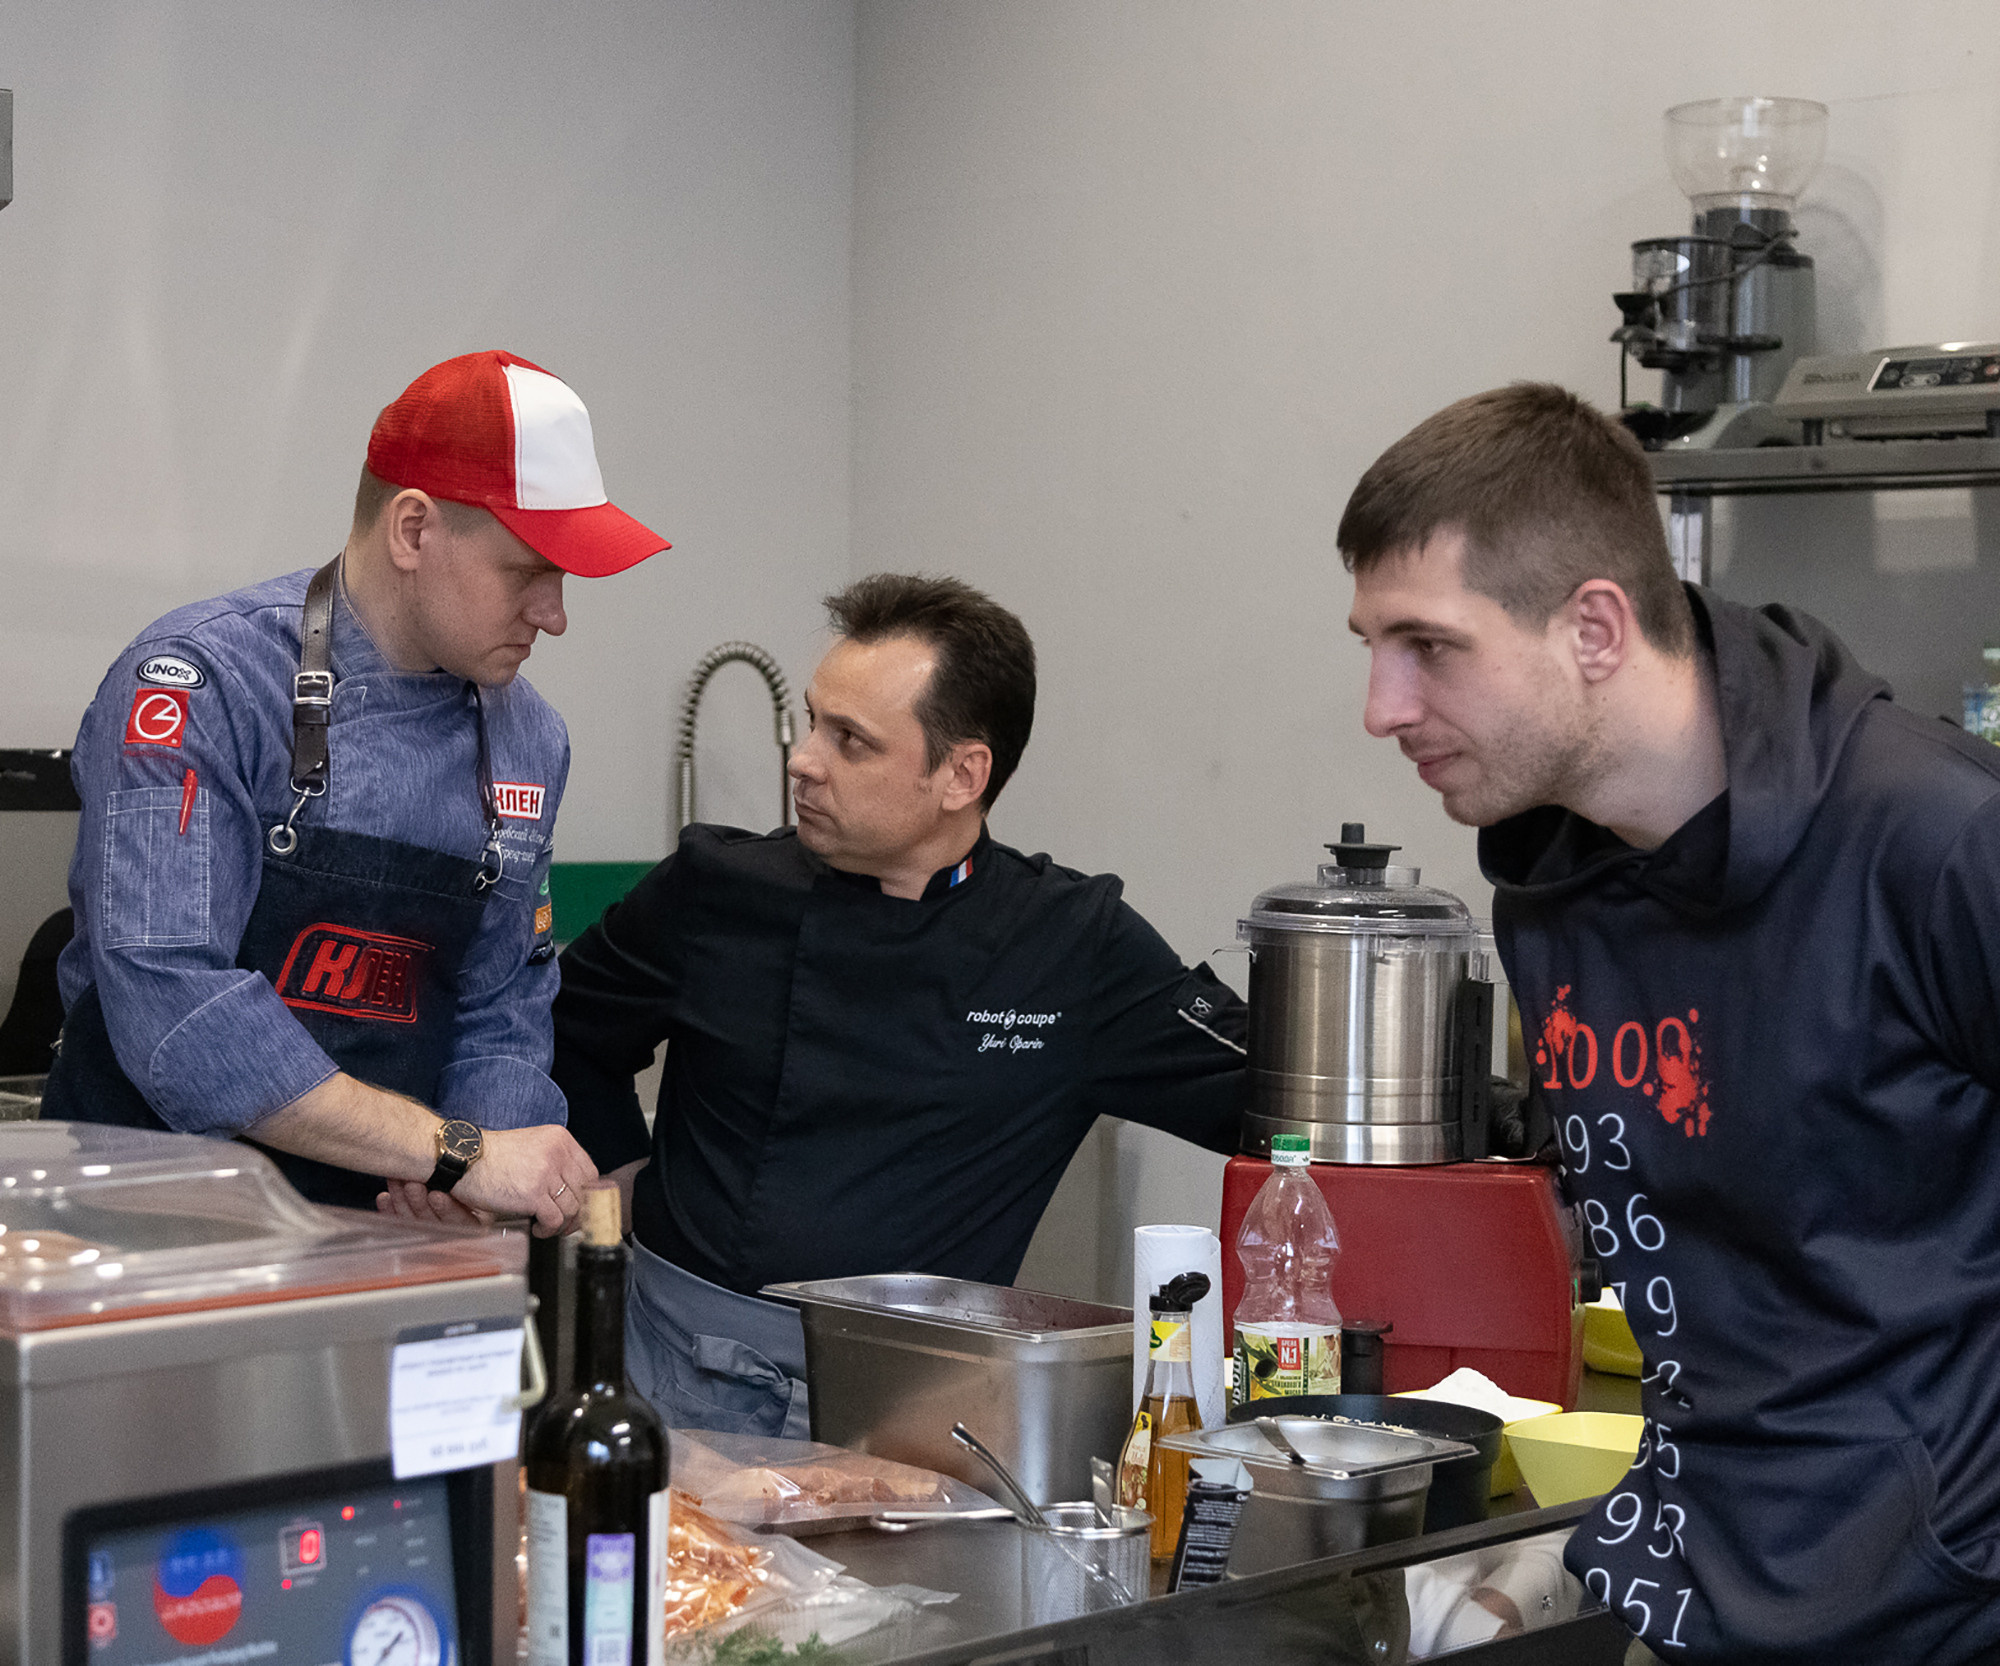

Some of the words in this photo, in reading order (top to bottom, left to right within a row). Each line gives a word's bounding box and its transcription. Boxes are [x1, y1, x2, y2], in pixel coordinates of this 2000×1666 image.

[146, 663, 192, 681] UNOX
[966, 1009, 1005, 1024] robot
[977, 1033, 1007, 1053] Yuri
[1009, 1034, 1045, 1055] Oparin
[1554, 1113, 1631, 1175] 93
